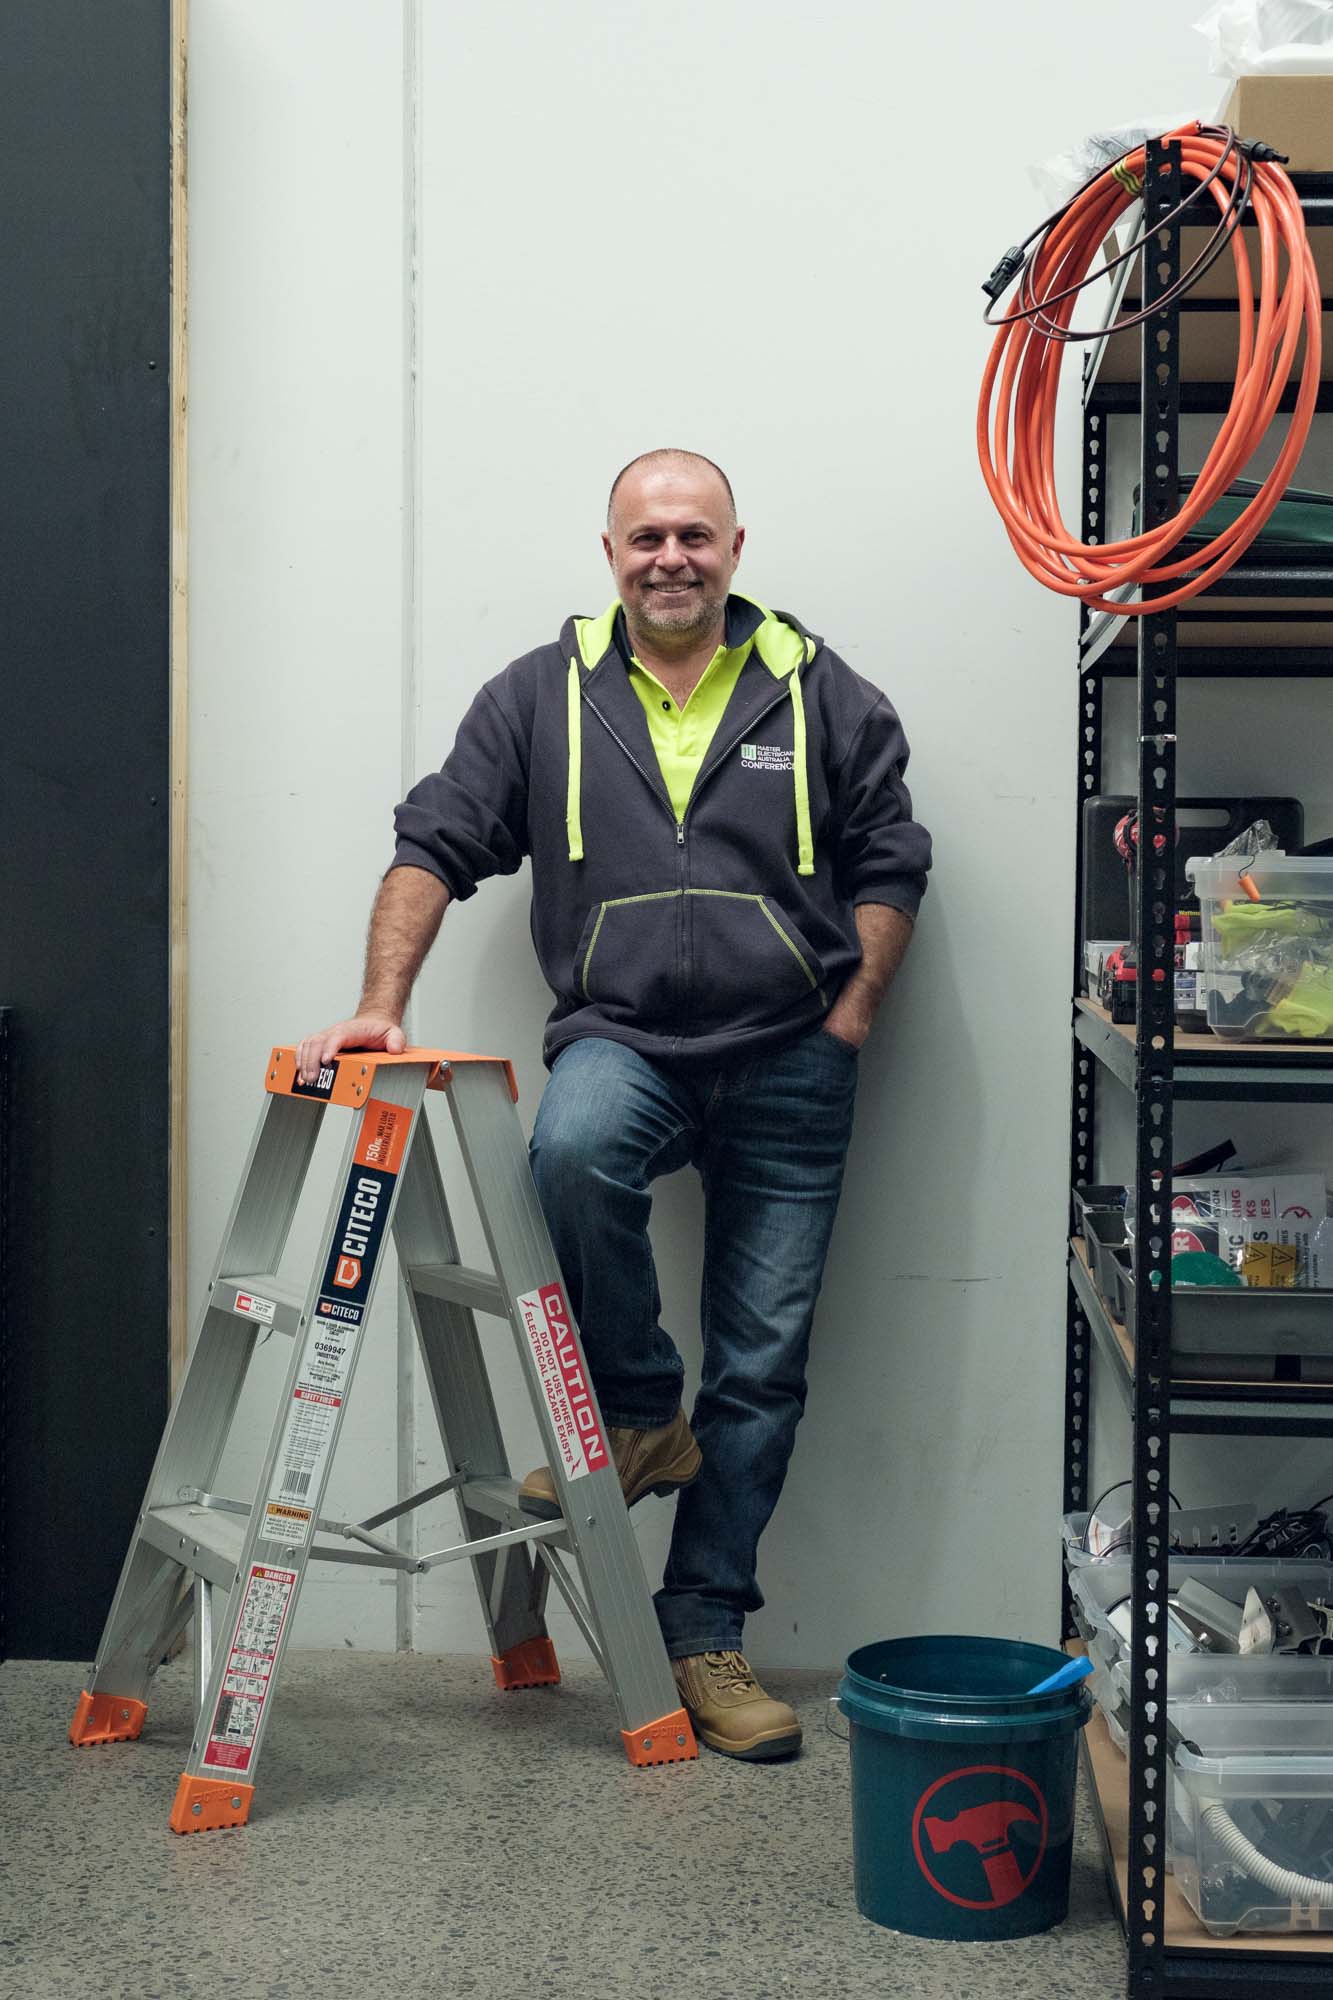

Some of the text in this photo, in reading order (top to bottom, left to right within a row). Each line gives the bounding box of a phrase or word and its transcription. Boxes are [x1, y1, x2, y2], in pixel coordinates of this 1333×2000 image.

[741, 760, 795, 770] CONFERENC
[341, 1176, 382, 1257] CITECO
[331, 1304, 360, 1320] CITECO
[314, 1342, 347, 1356] 0369947
[539, 1331, 575, 1436] DO NOT USE WHERE
[543, 1293, 604, 1460] CAUTION
[524, 1311, 574, 1463] ELECTRICAL HAZARD EXISTS
[276, 1505, 309, 1520] WARNING
[264, 1570, 292, 1582] DANGER
